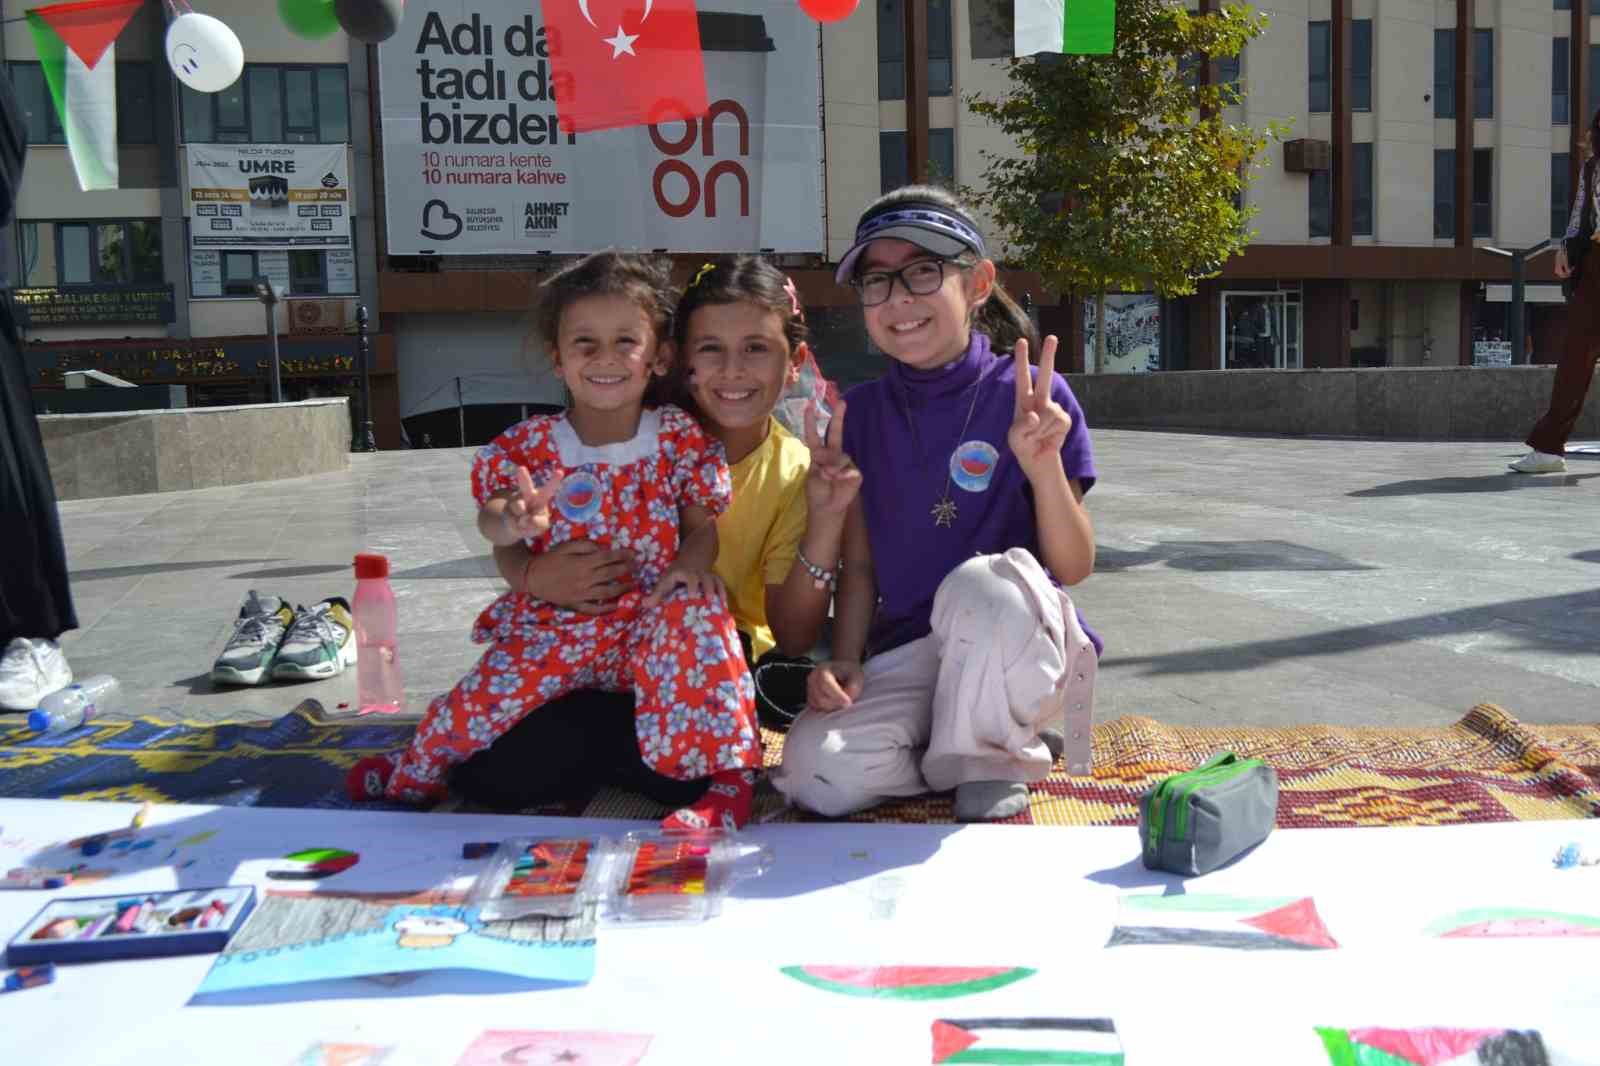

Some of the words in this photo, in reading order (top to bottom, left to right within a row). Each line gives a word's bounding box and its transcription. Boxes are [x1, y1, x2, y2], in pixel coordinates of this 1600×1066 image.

[415, 11, 492, 56] Adı
[504, 14, 562, 58] da
[416, 59, 506, 101] tadı
[517, 59, 575, 102] da
[421, 103, 576, 145] bizden
[239, 160, 296, 173] UMRE
[422, 152, 440, 167] 10
[444, 153, 505, 167] numara
[510, 151, 552, 168] kente
[422, 169, 441, 185] 10
[446, 171, 512, 185] numara
[516, 168, 566, 185] kahve
[652, 159, 749, 218] on
[525, 202, 569, 216] AHMET
[525, 216, 558, 229] AKIN
